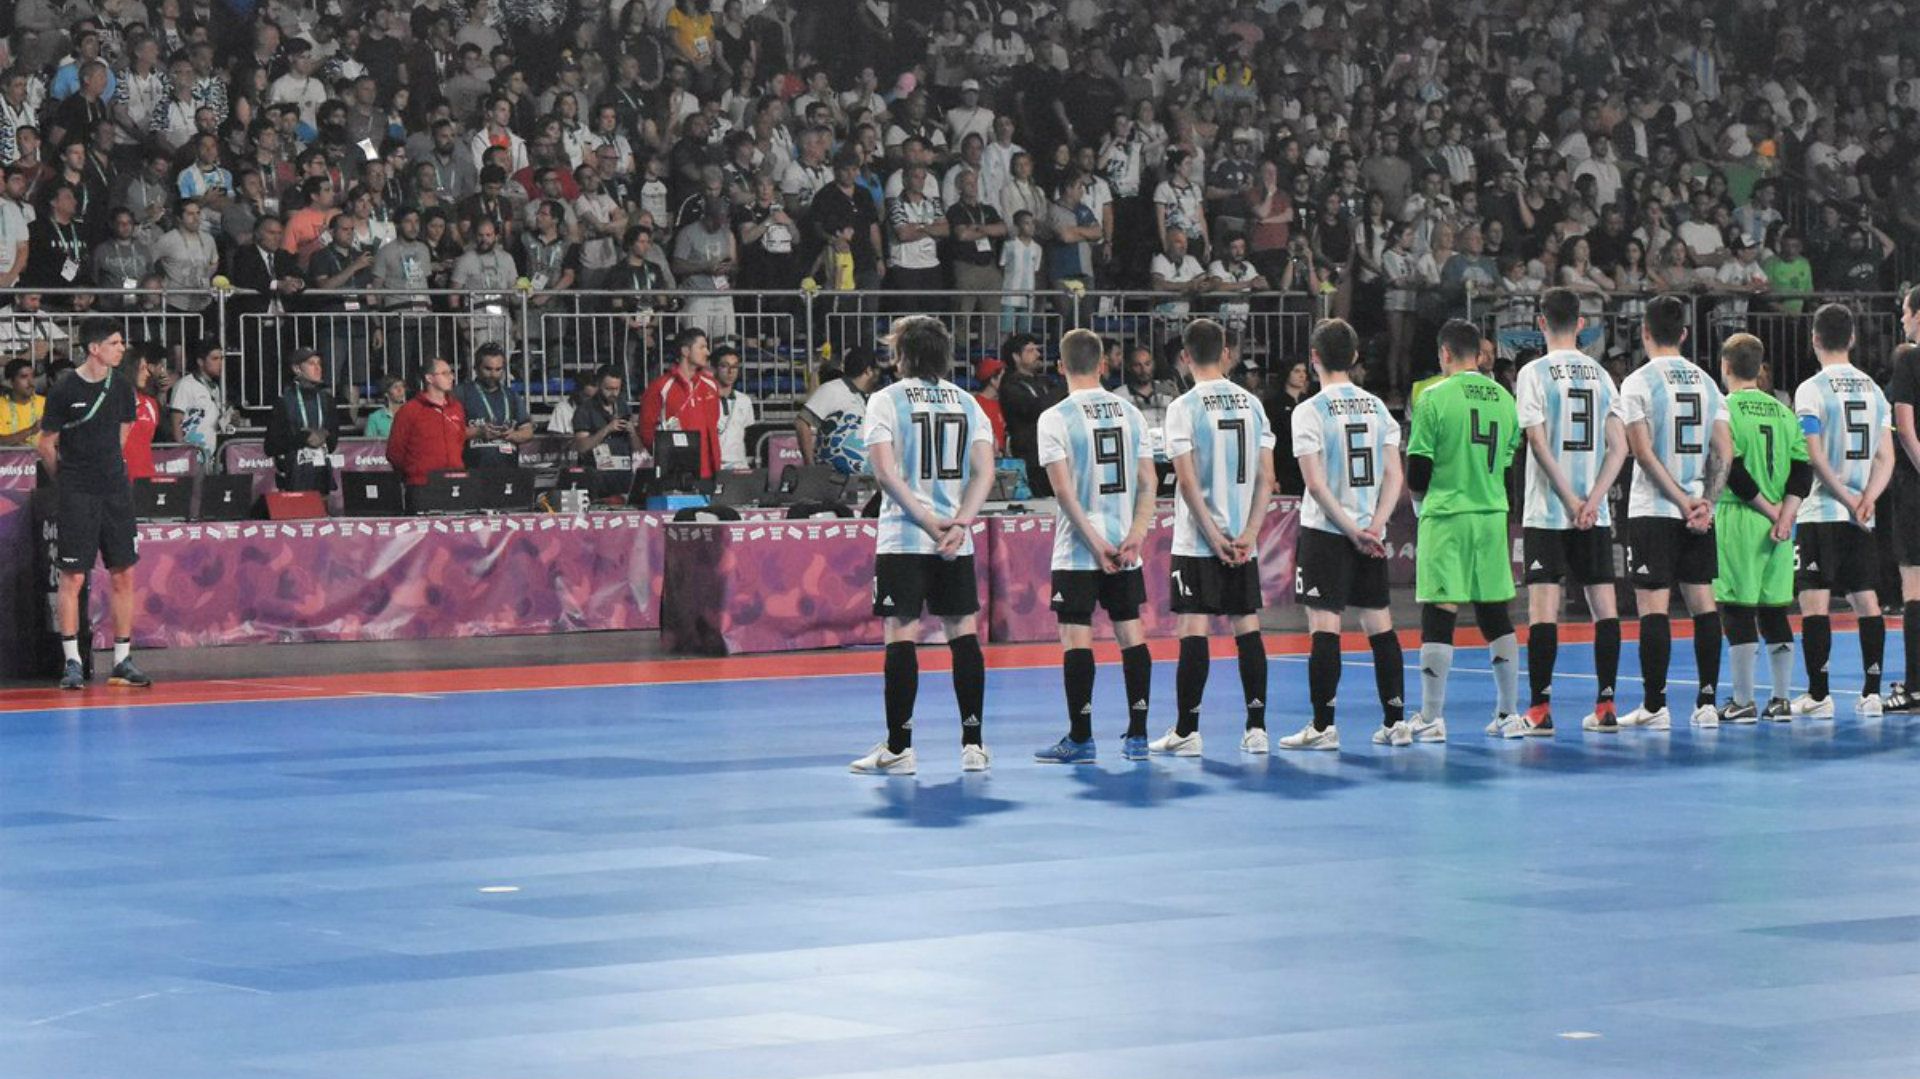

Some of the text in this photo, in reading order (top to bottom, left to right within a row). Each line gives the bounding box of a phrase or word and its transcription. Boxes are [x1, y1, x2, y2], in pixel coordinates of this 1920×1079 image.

[1082, 401, 1124, 420] RUFINO
[1202, 393, 1250, 411] RAMIREZ
[1563, 388, 1594, 451] 3
[1675, 393, 1703, 453] 2
[1844, 400, 1870, 460] 5
[911, 411, 968, 480] 10
[1093, 426, 1127, 495] 9
[1217, 418, 1246, 484] 7
[1345, 422, 1375, 487] 6
[1470, 408, 1498, 474] 4
[1759, 424, 1774, 481] 1
